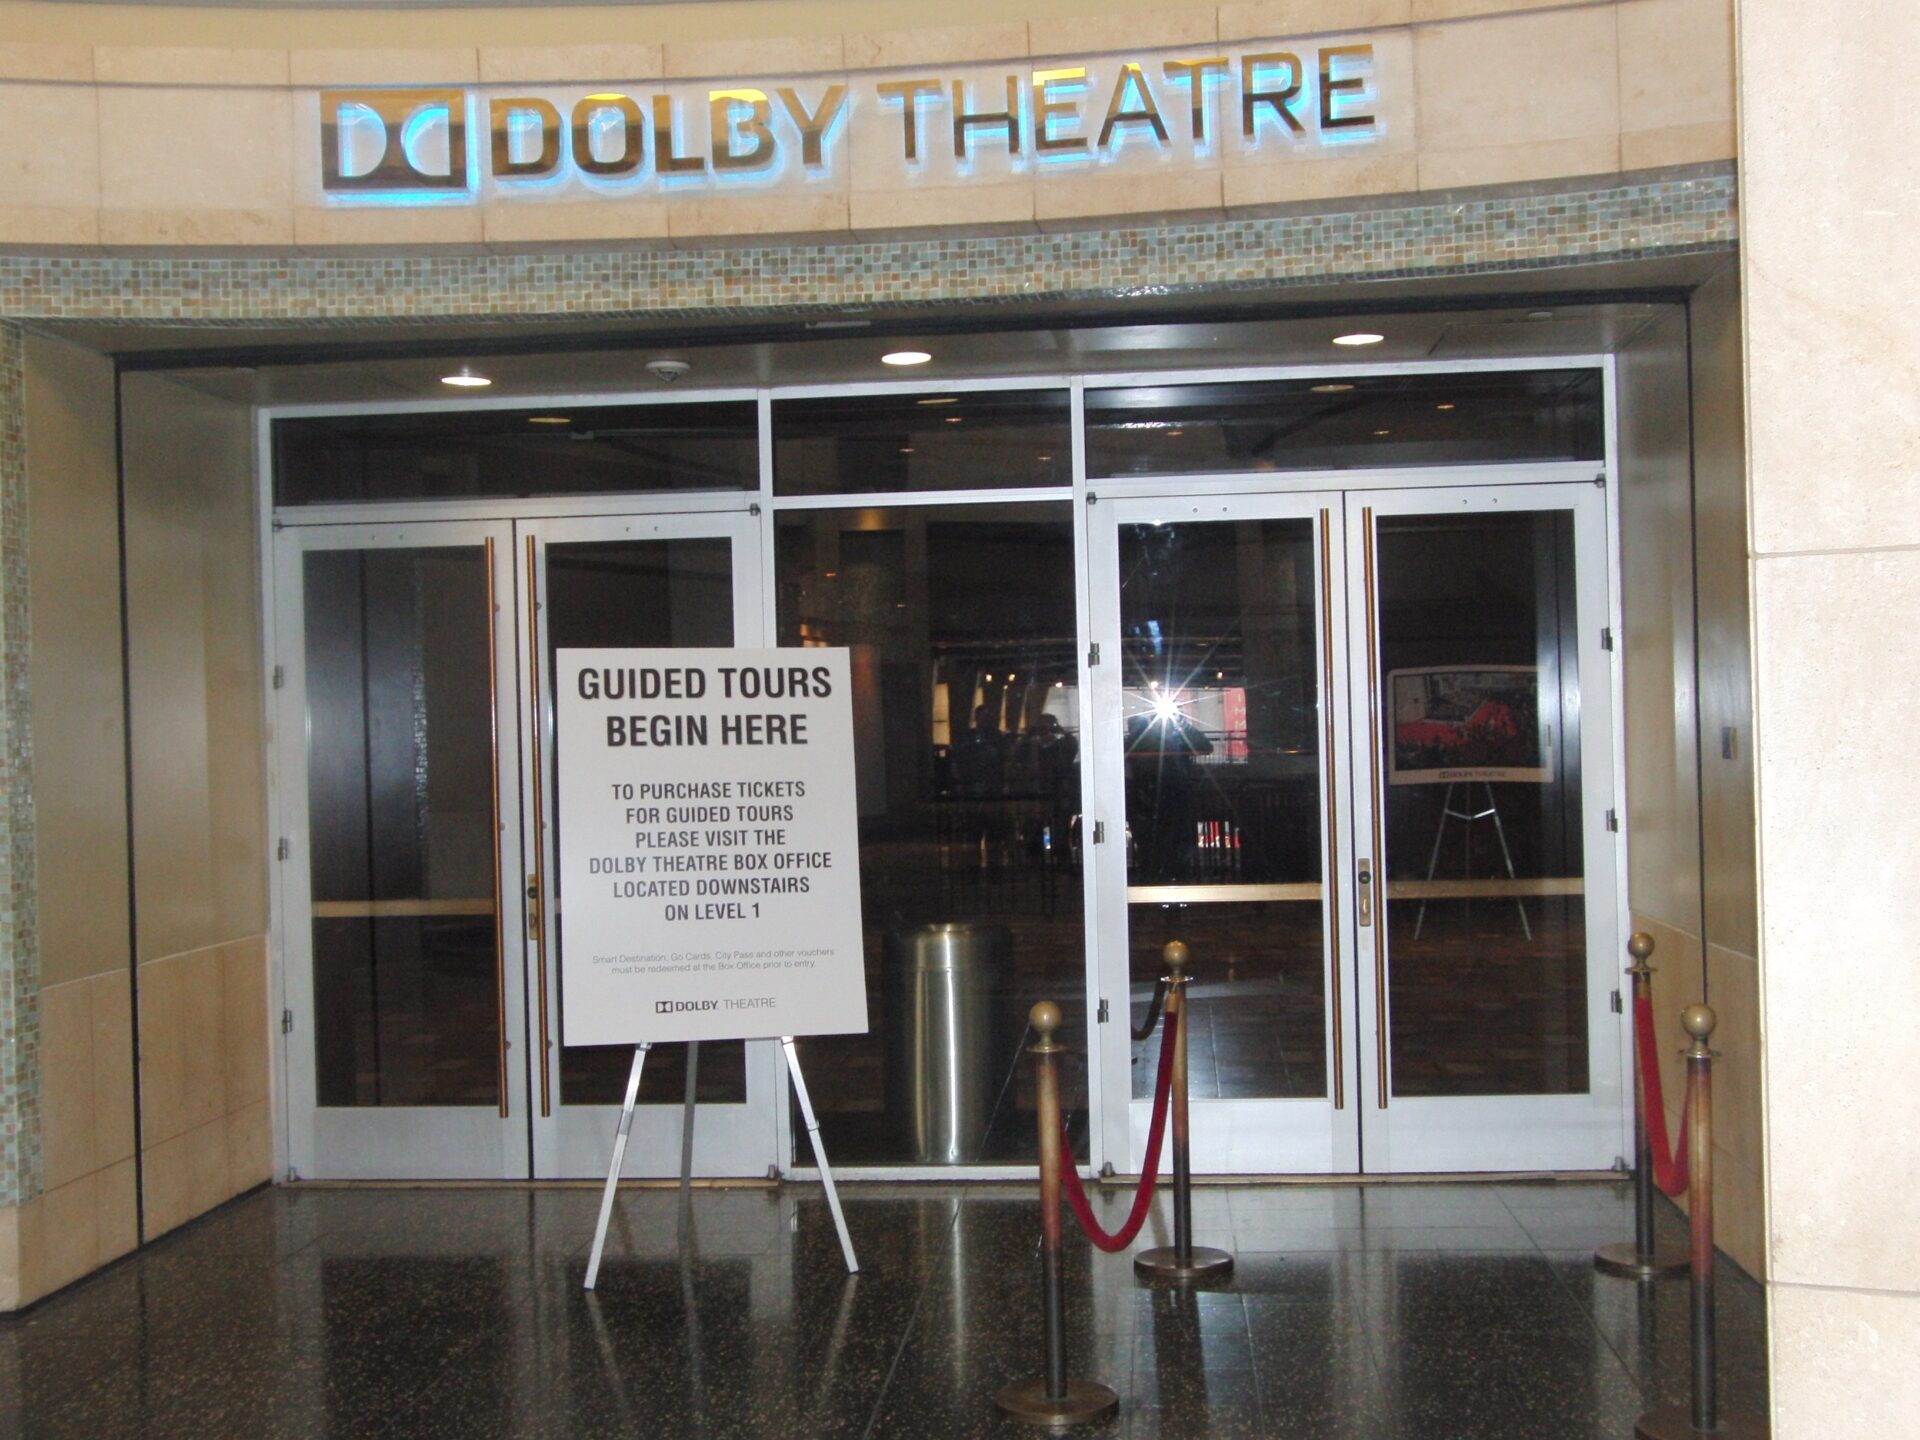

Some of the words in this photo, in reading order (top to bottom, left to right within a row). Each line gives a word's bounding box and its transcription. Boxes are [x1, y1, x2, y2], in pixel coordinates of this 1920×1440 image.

[489, 83, 847, 176] DOLBY
[876, 43, 1376, 163] THEATRE
[578, 667, 706, 700] GUIDED
[718, 666, 832, 698] TOURS
[606, 714, 708, 747] BEGIN
[721, 714, 808, 745] HERE
[612, 784, 633, 800] TO
[640, 782, 731, 799] PURCHASE
[737, 781, 805, 798] TICKETS
[626, 808, 660, 824] FOR
[666, 806, 730, 823] GUIDED
[736, 805, 793, 821] TOURS
[635, 831, 699, 848] PLEASE
[705, 830, 748, 846] VISIT
[754, 830, 785, 845] THE
[590, 857, 646, 874] DOLBY
[653, 855, 728, 872] THEATRE
[734, 854, 768, 870] BOX
[774, 852, 831, 869] OFFICE
[613, 880, 689, 898] LOCATED
[696, 877, 809, 895] DOWNSTAIRS
[665, 905, 688, 921] ON
[695, 903, 746, 920] LEVEL
[752, 903, 760, 918] 1
[592, 955, 618, 964] Smart
[670, 952, 684, 962] Go
[715, 951, 732, 961] City
[734, 950, 754, 959] Pass
[756, 949, 772, 958] and
[774, 949, 795, 957] other
[797, 947, 835, 957] vouchers
[611, 966, 633, 974] must
[635, 965, 646, 973] be
[648, 963, 691, 973] redeemed
[693, 963, 701, 971] at
[702, 962, 716, 971] the
[718, 961, 734, 971] Box
[736, 961, 761, 970] Office
[763, 960, 782, 970] prior
[784, 960, 793, 968] to
[675, 1000, 718, 1012] DOLBY
[723, 998, 776, 1010] THEATRE
